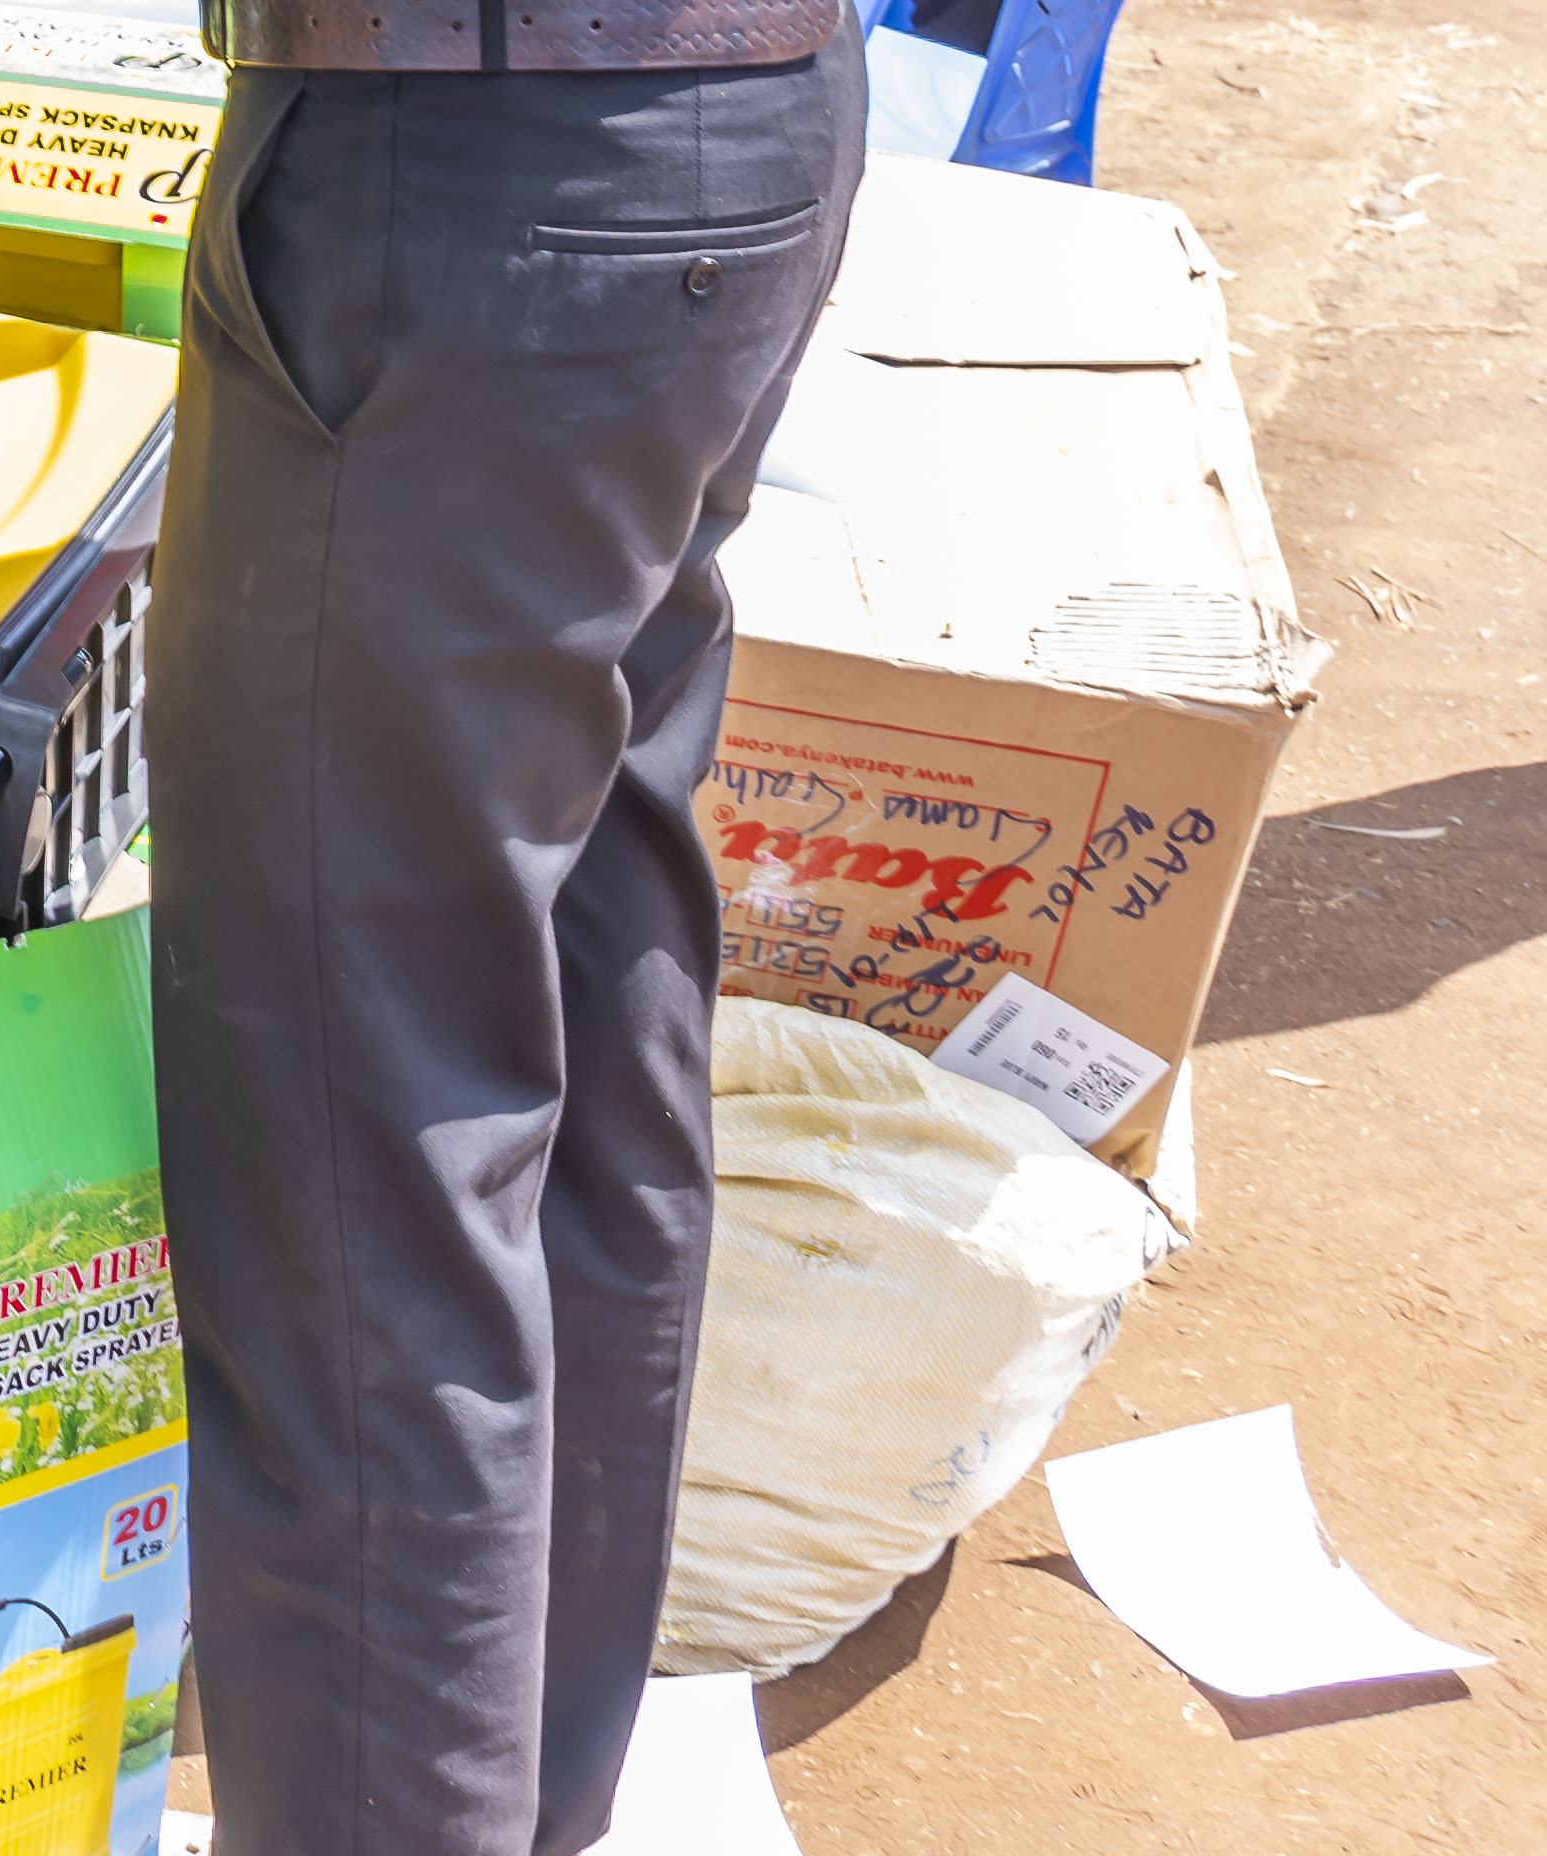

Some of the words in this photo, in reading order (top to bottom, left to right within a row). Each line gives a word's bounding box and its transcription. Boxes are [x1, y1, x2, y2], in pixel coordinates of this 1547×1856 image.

[27, 131, 128, 161] HEAVY
[41, 107, 199, 142] KNAPSACK
[725, 734, 975, 790] www.batakenya.com
[719, 821, 1035, 921] Bata
[1110, 806, 1218, 923] BATA
[79, 1287, 165, 1338] DUTY
[72, 1318, 183, 1375] SPRAYE
[112, 1495, 169, 1546] 20
[119, 1538, 164, 1567] Lts
